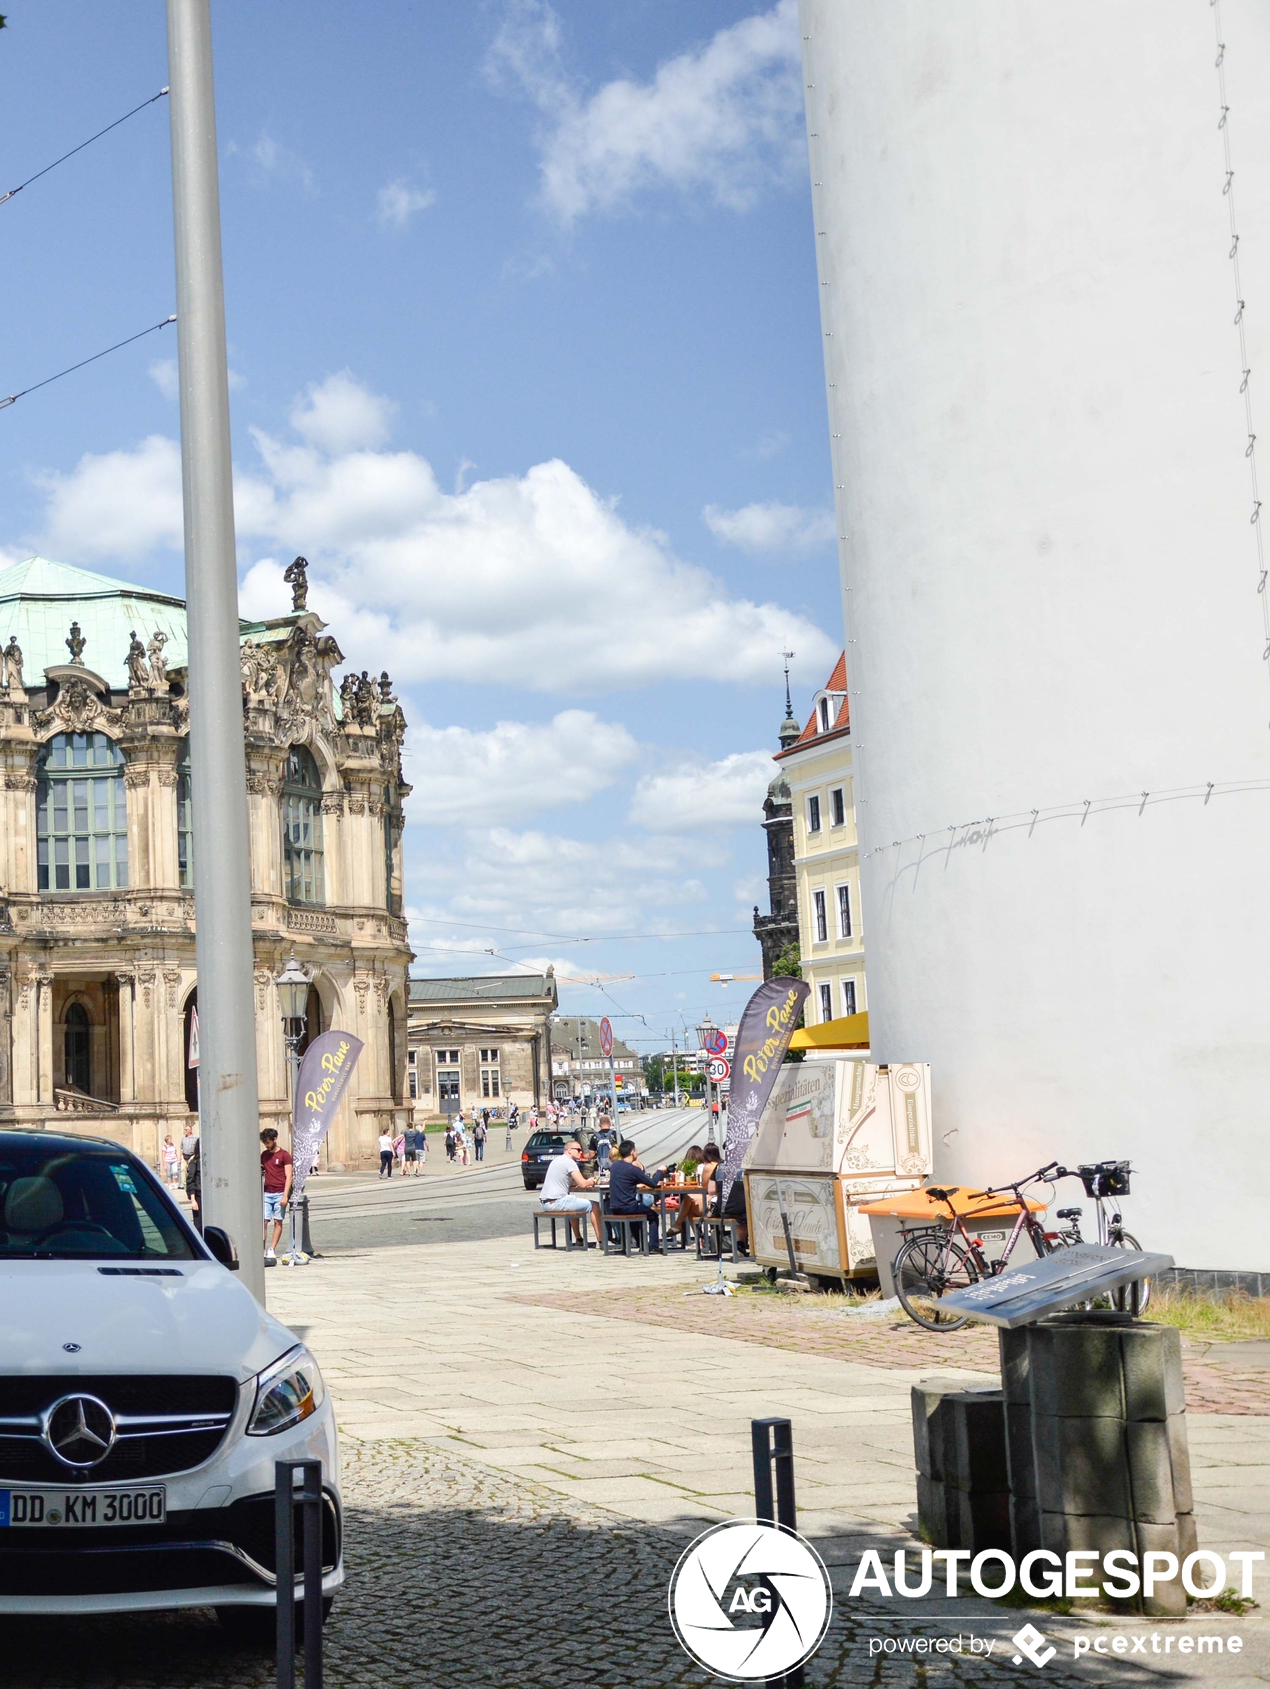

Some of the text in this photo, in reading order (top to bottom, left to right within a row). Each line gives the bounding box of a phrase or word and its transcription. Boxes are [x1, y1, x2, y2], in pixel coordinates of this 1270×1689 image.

[743, 1038, 780, 1084] Peter
[765, 988, 799, 1034] Pane
[305, 1040, 351, 1113] Peter Pane
[709, 1063, 725, 1076] 30
[852, 1064, 863, 1110] Hausgemachte
[12, 1492, 163, 1523] DD KM 3000
